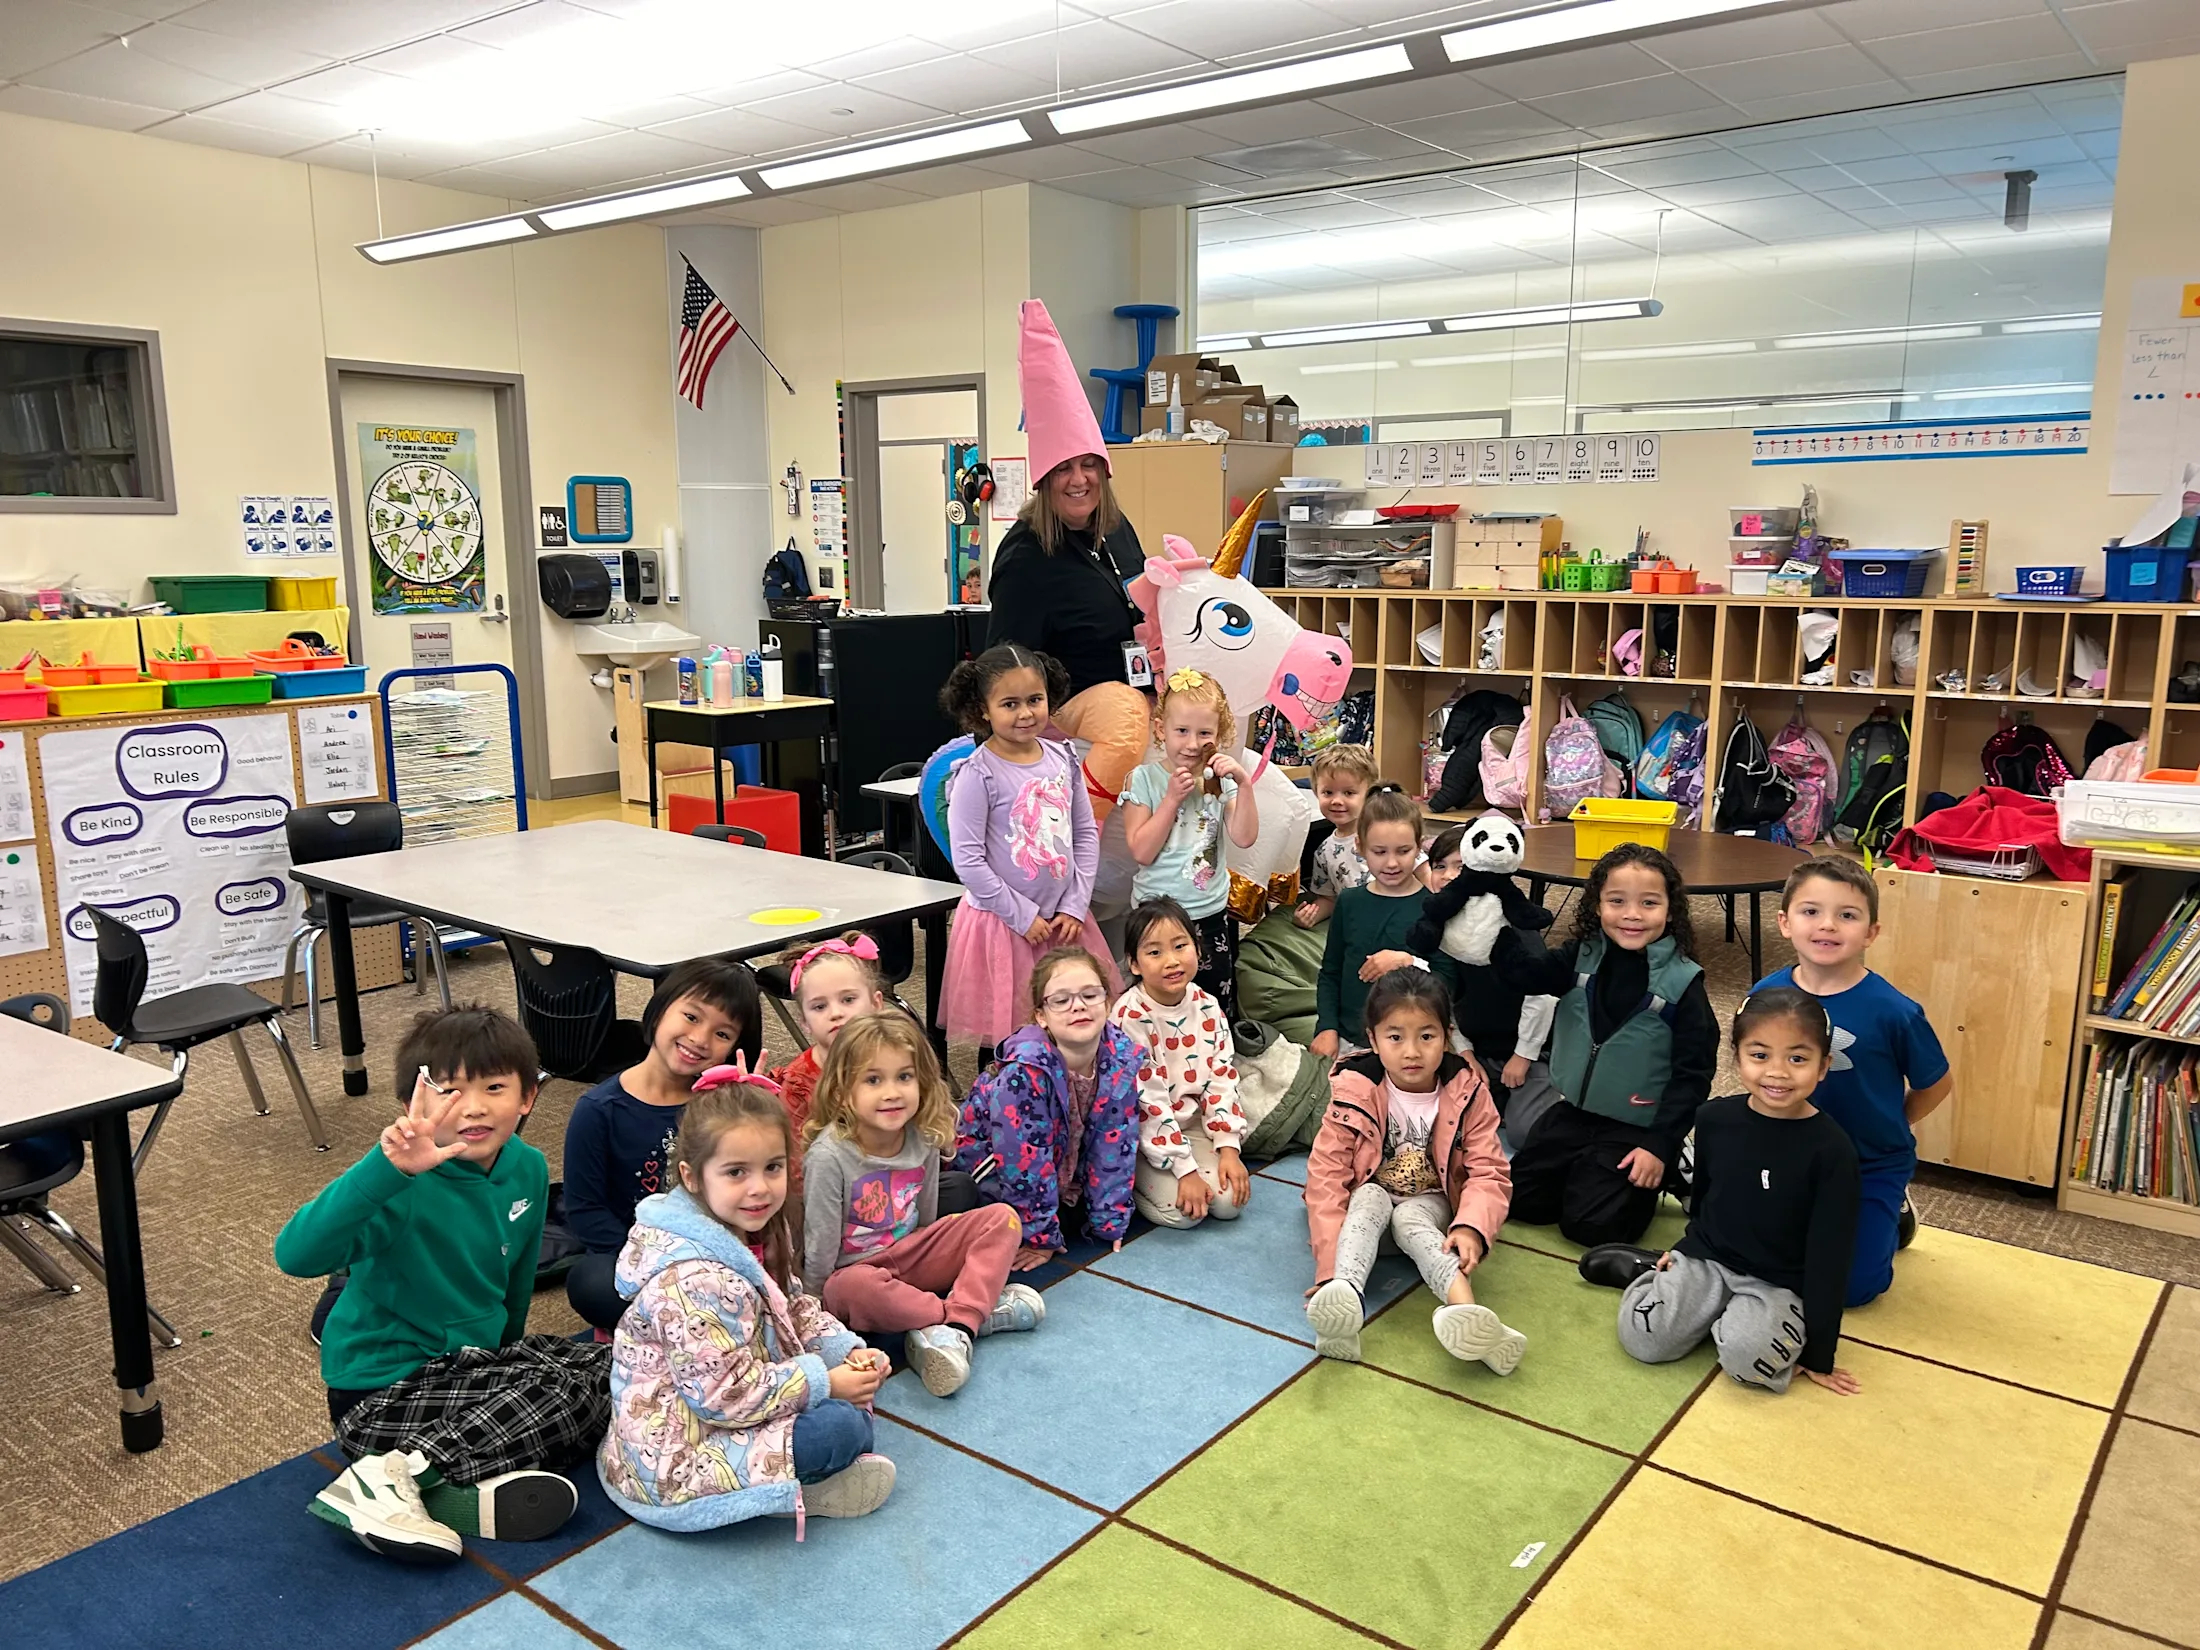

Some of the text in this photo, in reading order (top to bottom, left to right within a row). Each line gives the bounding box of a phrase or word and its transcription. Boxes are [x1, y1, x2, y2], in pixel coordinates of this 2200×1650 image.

[2138, 334, 2175, 346] Fewer
[2157, 351, 2185, 362] than
[374, 427, 460, 446] IT'S YOUR CHOICE!
[1756, 445, 1763, 454] 0
[1783, 445, 1789, 454] 2
[1796, 445, 1803, 453] 3
[1810, 444, 1816, 452] 4
[1824, 444, 1831, 452] 5
[1838, 443, 1845, 451] 6
[1853, 442, 1859, 451] 7
[1866, 442, 1874, 450] 8
[1882, 441, 1888, 449] 9
[1893, 440, 1904, 449] 10
[1915, 440, 1922, 448] 11
[1930, 439, 1940, 447] 12
[1948, 438, 1957, 446] 13
[1965, 437, 1974, 446] 14
[1981, 437, 1991, 445] 15
[1999, 436, 2008, 444] 16
[2017, 435, 2027, 444] 17
[2034, 434, 2044, 443] 18
[2052, 433, 2061, 442] 19
[2067, 432, 2081, 442] 20
[1400, 448, 1409, 464] 2
[1428, 447, 1438, 463] 3
[1456, 446, 1465, 462] 4
[1485, 445, 1496, 461] 5
[1515, 444, 1525, 460] 6
[1545, 442, 1554, 459] 7
[1575, 440, 1586, 458] 8
[1607, 440, 1617, 457] 9
[1637, 438, 1654, 457] 10
[1483, 463, 1497, 471] five
[1570, 459, 1589, 469] eight
[127, 743, 221, 759] Classroom
[237, 755, 283, 765] Good behavior
[154, 770, 200, 785] Rules
[80, 816, 132, 832] Be Kind
[190, 808, 283, 827] Be Responsible
[139, 846, 162, 854] others
[199, 844, 219, 853] Clean
[225, 889, 271, 904] Be Safe
[75, 906, 169, 931] Be spectful
[2103, 905, 2115, 939] ULTIMATE
